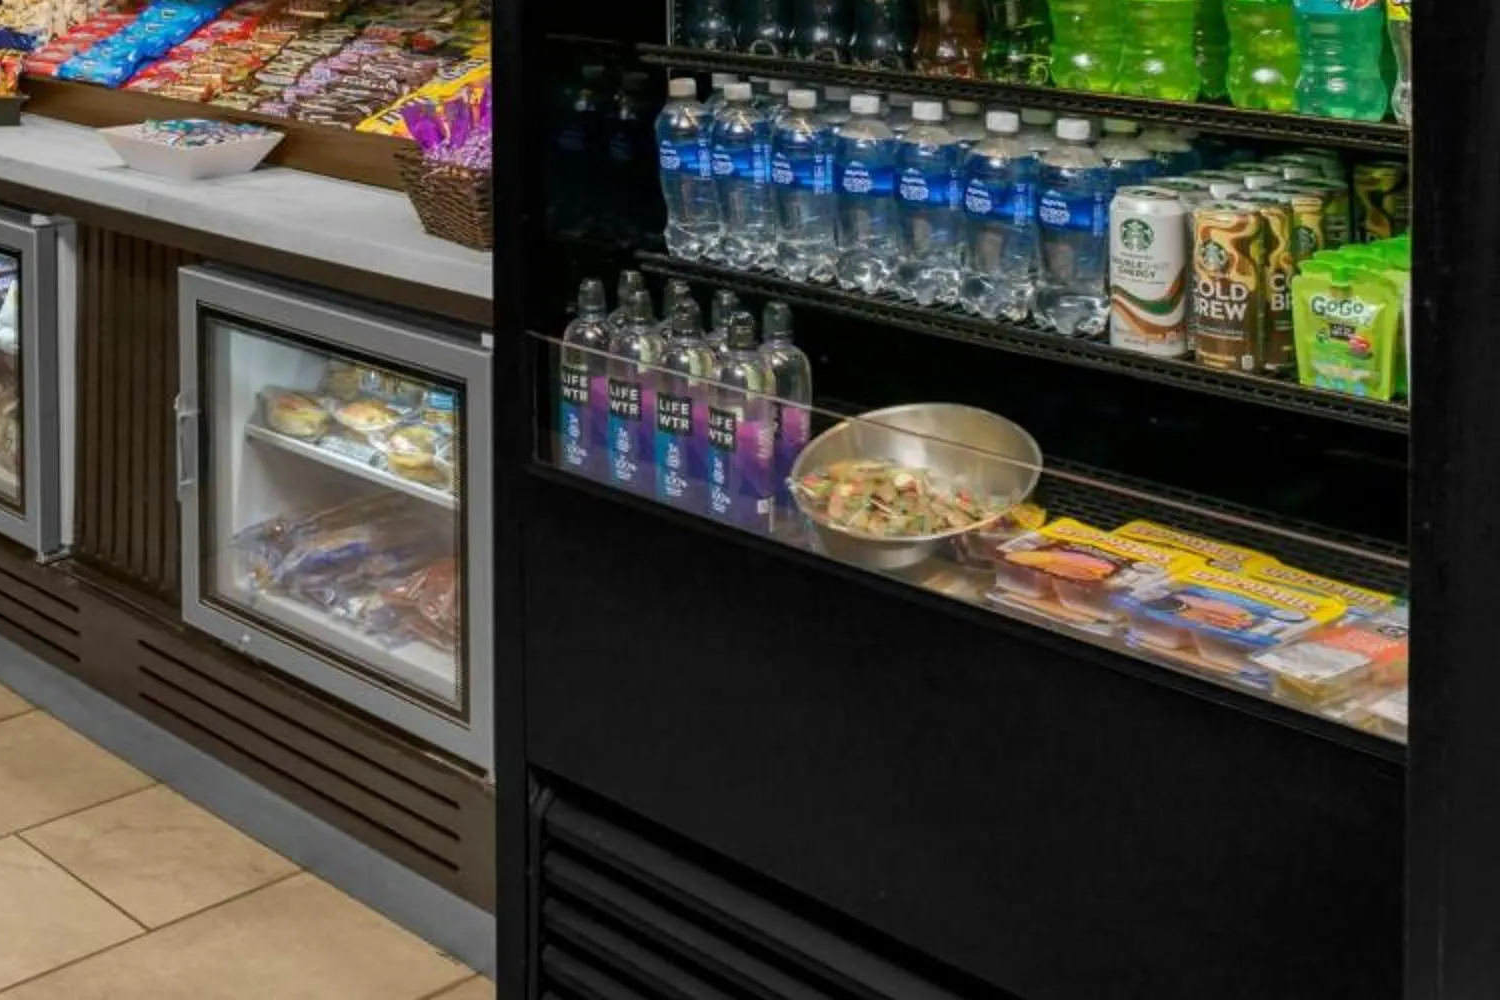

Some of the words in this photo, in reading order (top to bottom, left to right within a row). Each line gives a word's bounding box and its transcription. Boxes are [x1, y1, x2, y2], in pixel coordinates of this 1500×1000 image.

[1193, 277, 1249, 301] OLD
[610, 384, 639, 401] LIFE
[611, 399, 639, 416] WTR
[659, 398, 690, 416] LIFE
[659, 414, 690, 431] WTR
